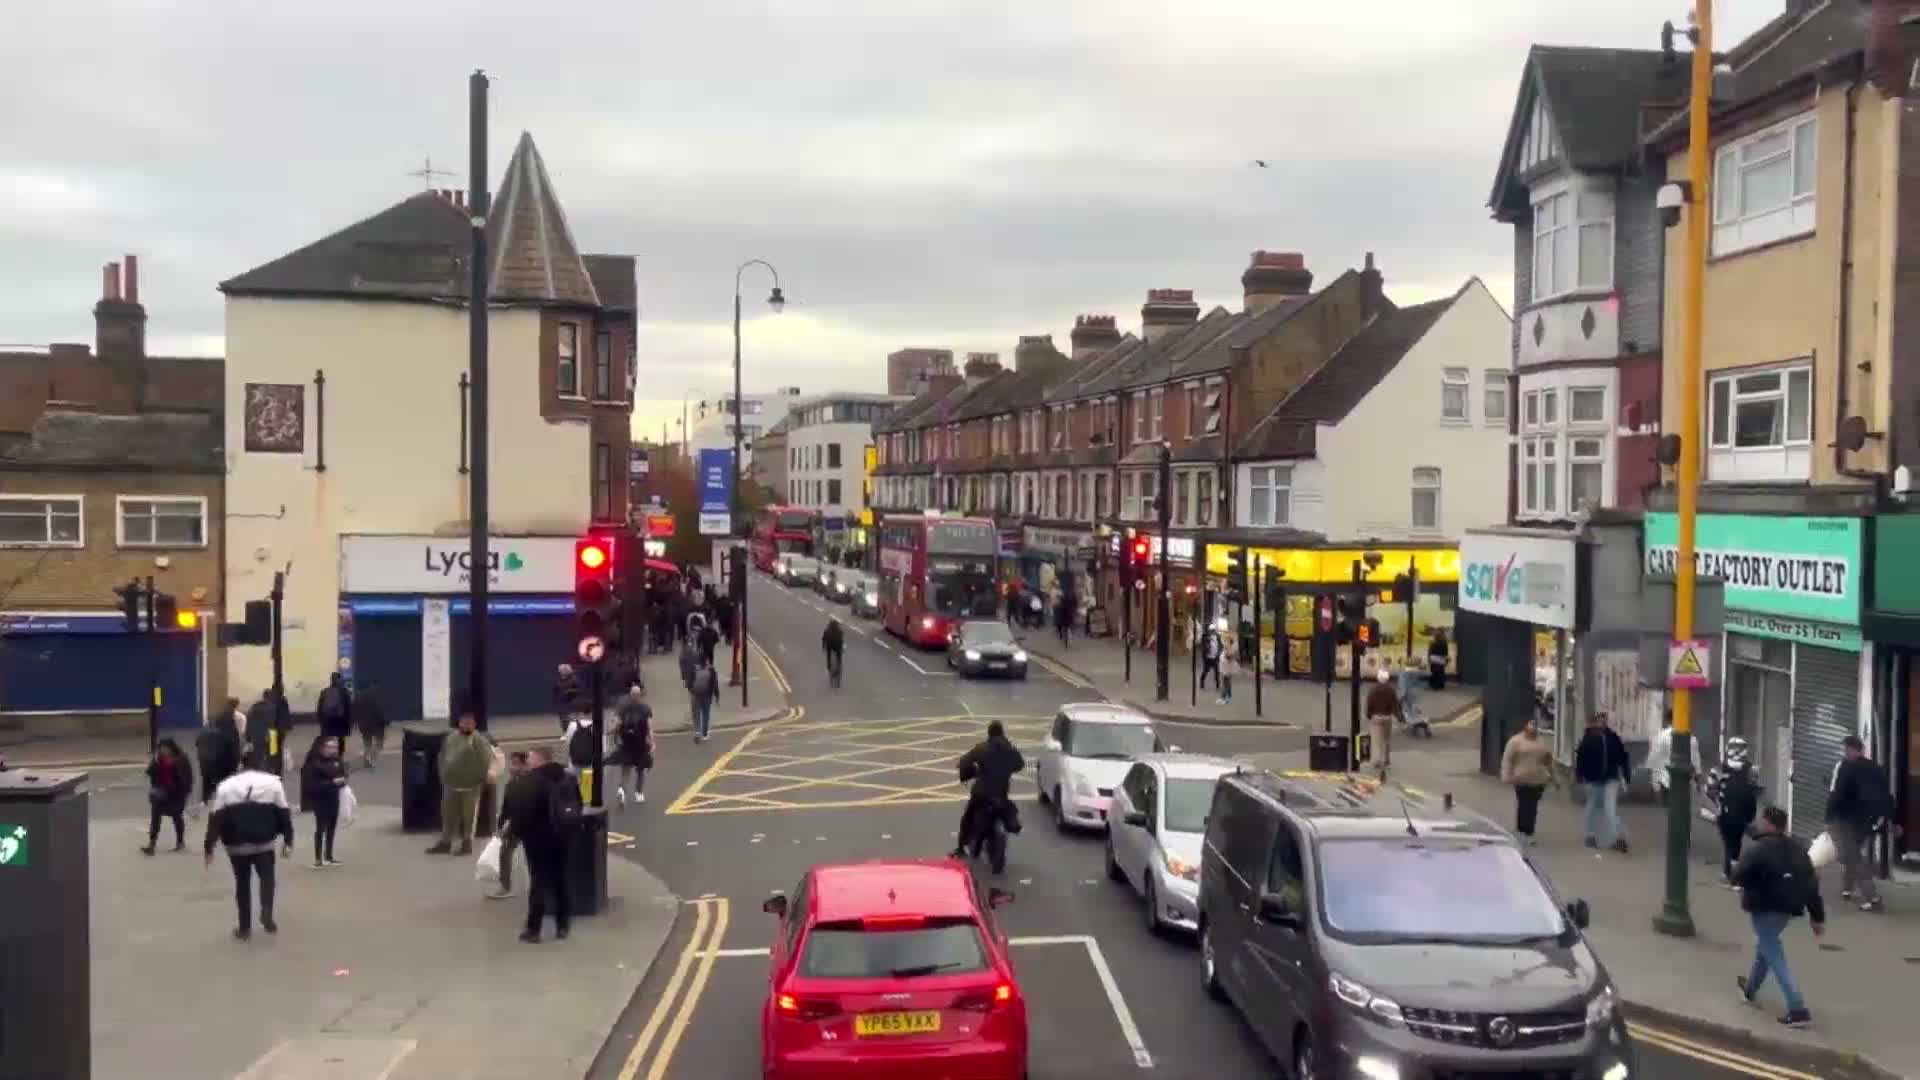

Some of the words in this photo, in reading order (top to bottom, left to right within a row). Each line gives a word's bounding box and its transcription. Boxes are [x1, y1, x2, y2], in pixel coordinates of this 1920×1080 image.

[1463, 550, 1521, 604] save
[1703, 553, 1772, 586] FACTORY
[1777, 559, 1845, 594] OUTLET
[1768, 619, 1792, 634] Over
[1812, 622, 1841, 640] Years
[861, 1014, 902, 1033] YP65
